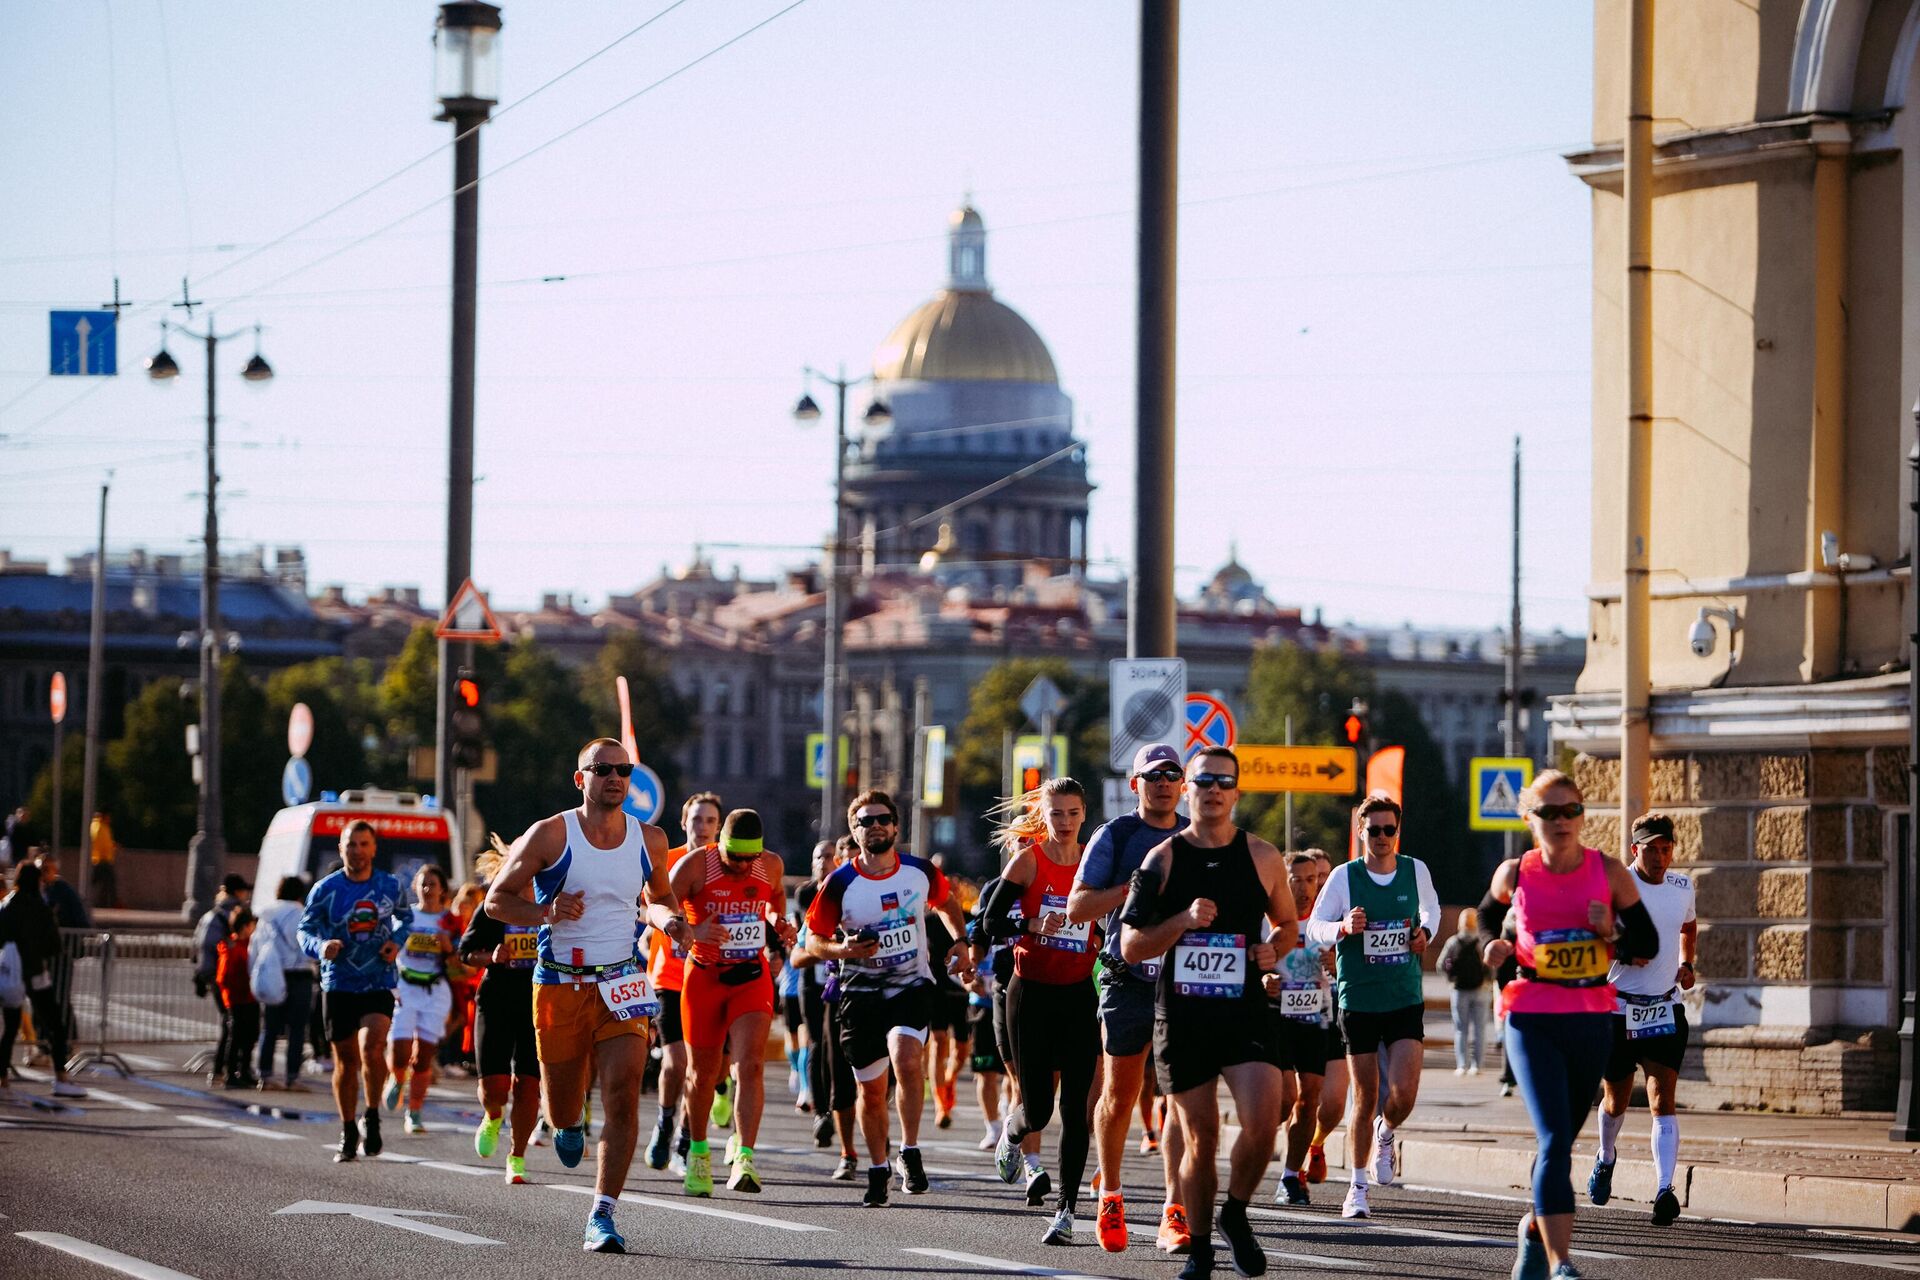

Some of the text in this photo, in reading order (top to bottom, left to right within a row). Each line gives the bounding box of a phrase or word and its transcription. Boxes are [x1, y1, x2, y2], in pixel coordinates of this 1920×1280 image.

[1666, 875, 1688, 887] EA7
[1040, 936, 1048, 945] D
[1370, 932, 1406, 947] 2478
[876, 958, 883, 967] D
[1184, 951, 1236, 972] 4072
[1369, 956, 1376, 964] C
[1545, 945, 1597, 968] 2071
[1148, 965, 1156, 975] D
[610, 980, 646, 1004] 6537
[1181, 984, 1190, 994] D
[1287, 993, 1318, 1006] 3624
[619, 1011, 628, 1019] D
[1632, 1006, 1667, 1021] 5772
